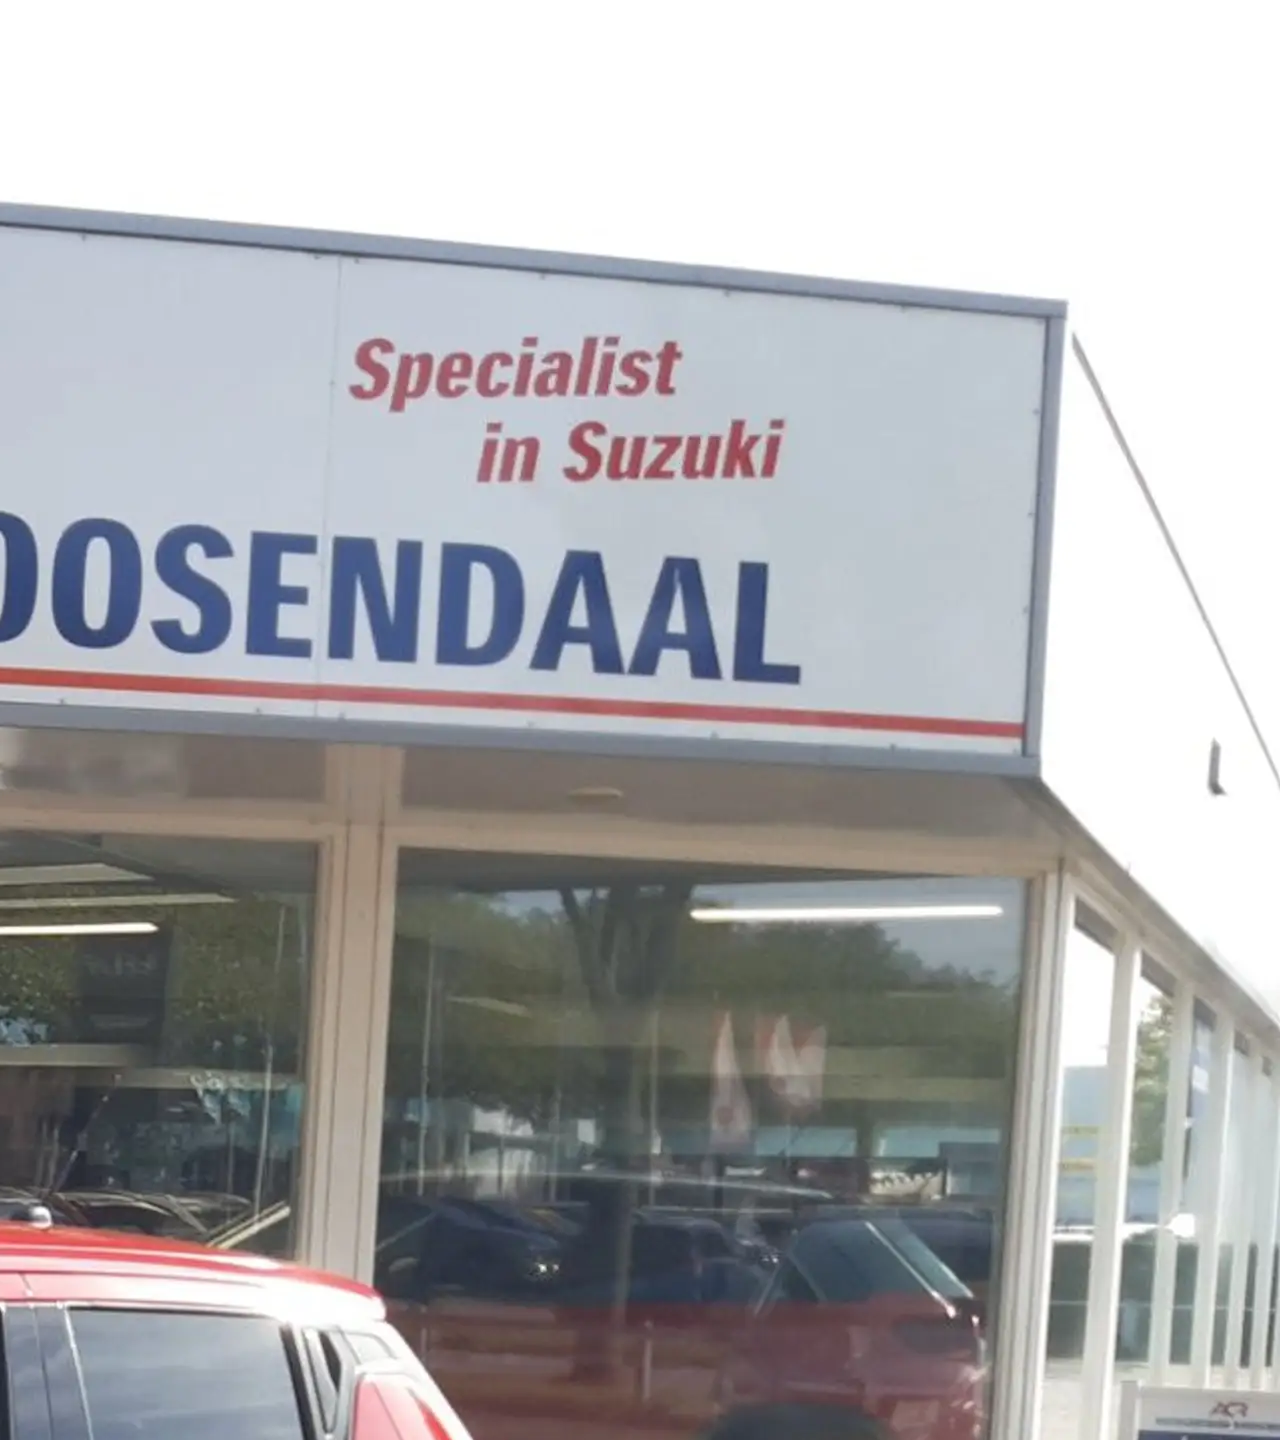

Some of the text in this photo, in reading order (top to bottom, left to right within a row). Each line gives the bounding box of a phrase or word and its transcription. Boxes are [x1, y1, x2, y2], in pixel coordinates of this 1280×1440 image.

[348, 336, 683, 413] Specialist
[476, 418, 787, 484] in Suzuki
